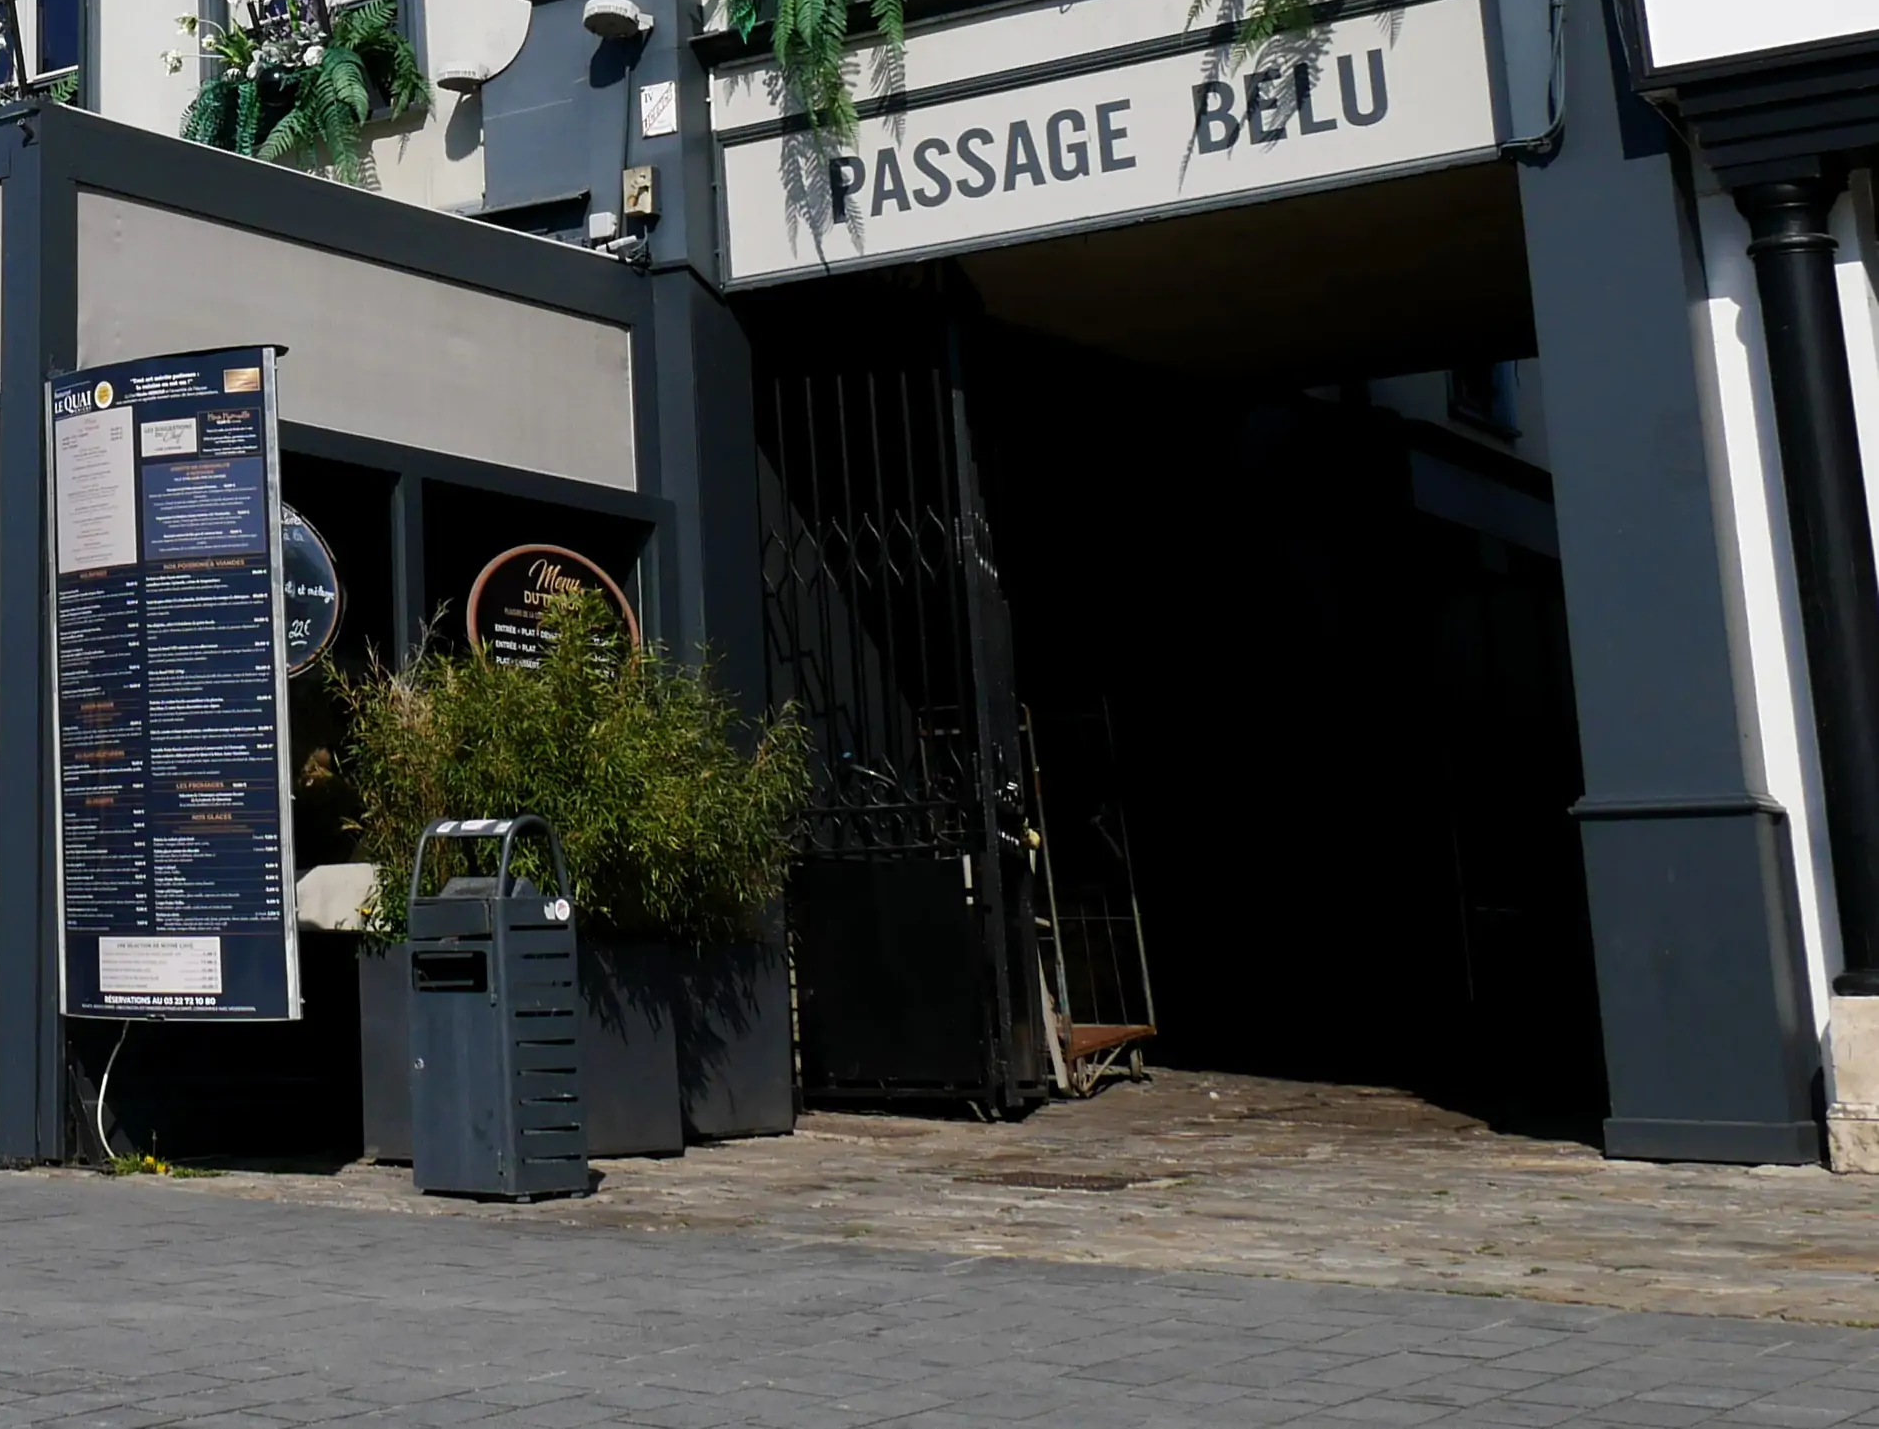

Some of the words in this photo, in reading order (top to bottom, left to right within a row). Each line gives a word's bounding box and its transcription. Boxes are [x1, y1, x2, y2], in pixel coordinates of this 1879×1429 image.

[828, 98, 1137, 225] PASSAGE
[1189, 47, 1390, 155] BELU
[54, 401, 64, 414] LE
[64, 390, 91, 413] QUAI
[529, 558, 582, 595] Menu
[524, 590, 539, 605] DU
[104, 994, 151, 1005] RÉSERVATIONS
[152, 996, 163, 1005] AU
[174, 996, 184, 1005] 22
[184, 996, 194, 1006] 72
[195, 996, 205, 1005] 10
